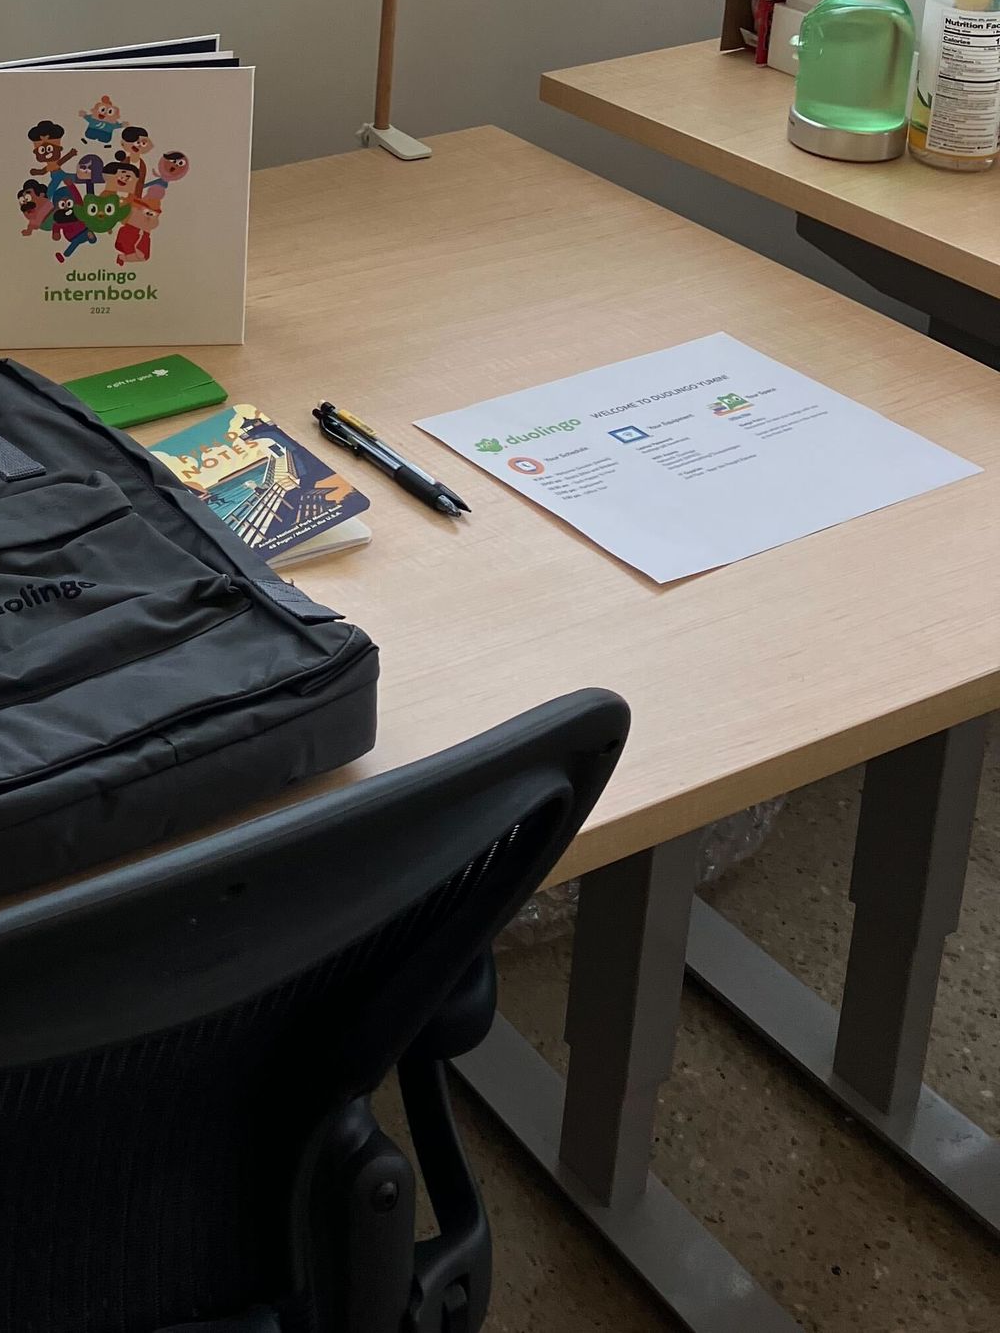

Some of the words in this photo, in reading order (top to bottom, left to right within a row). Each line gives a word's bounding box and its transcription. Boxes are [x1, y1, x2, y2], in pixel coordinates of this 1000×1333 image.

[945, 17, 984, 29] Nutrition
[943, 35, 971, 45] Calories
[66, 269, 137, 284] duolingo
[44, 285, 158, 301] internbook
[90, 306, 111, 315] 2022
[590, 401, 637, 420] WELCOME
[637, 397, 652, 407] TO
[651, 382, 697, 402] DUOLINGO
[505, 418, 582, 445] duolingo
[177, 431, 239, 464] FIELD
[181, 440, 259, 480] NOTES
[276, 526, 299, 539] National
[299, 519, 312, 527] Park
[276, 536, 293, 546] Pages
[295, 527, 311, 536] Made
